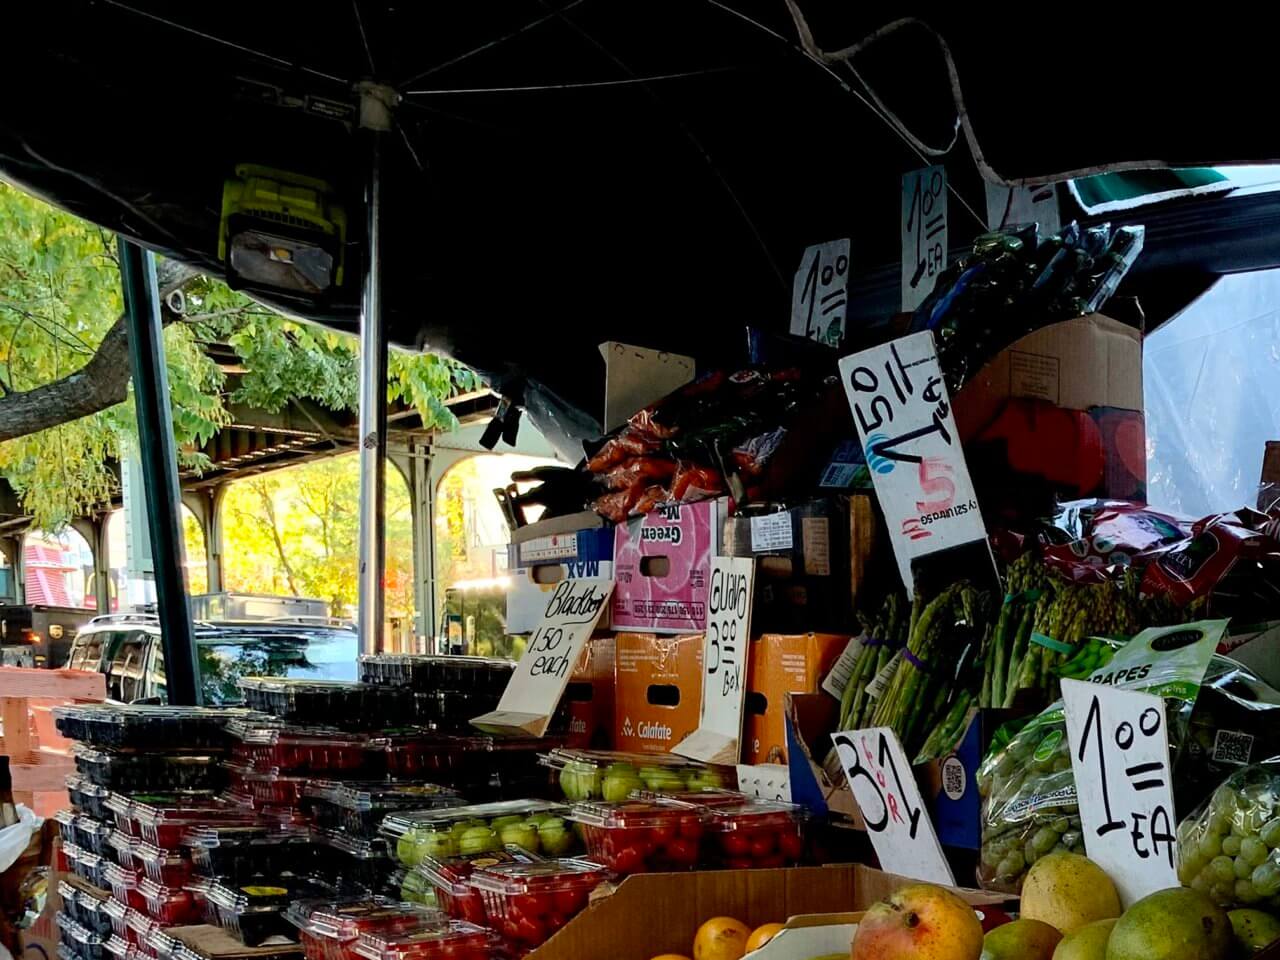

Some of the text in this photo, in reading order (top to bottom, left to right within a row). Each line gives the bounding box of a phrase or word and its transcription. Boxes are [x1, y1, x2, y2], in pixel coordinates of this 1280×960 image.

[640, 526, 682, 545] Green
[566, 560, 600, 579] MAX
[530, 648, 570, 679] each
[637, 721, 672, 741] Calafate
[1130, 804, 1177, 869] EA
